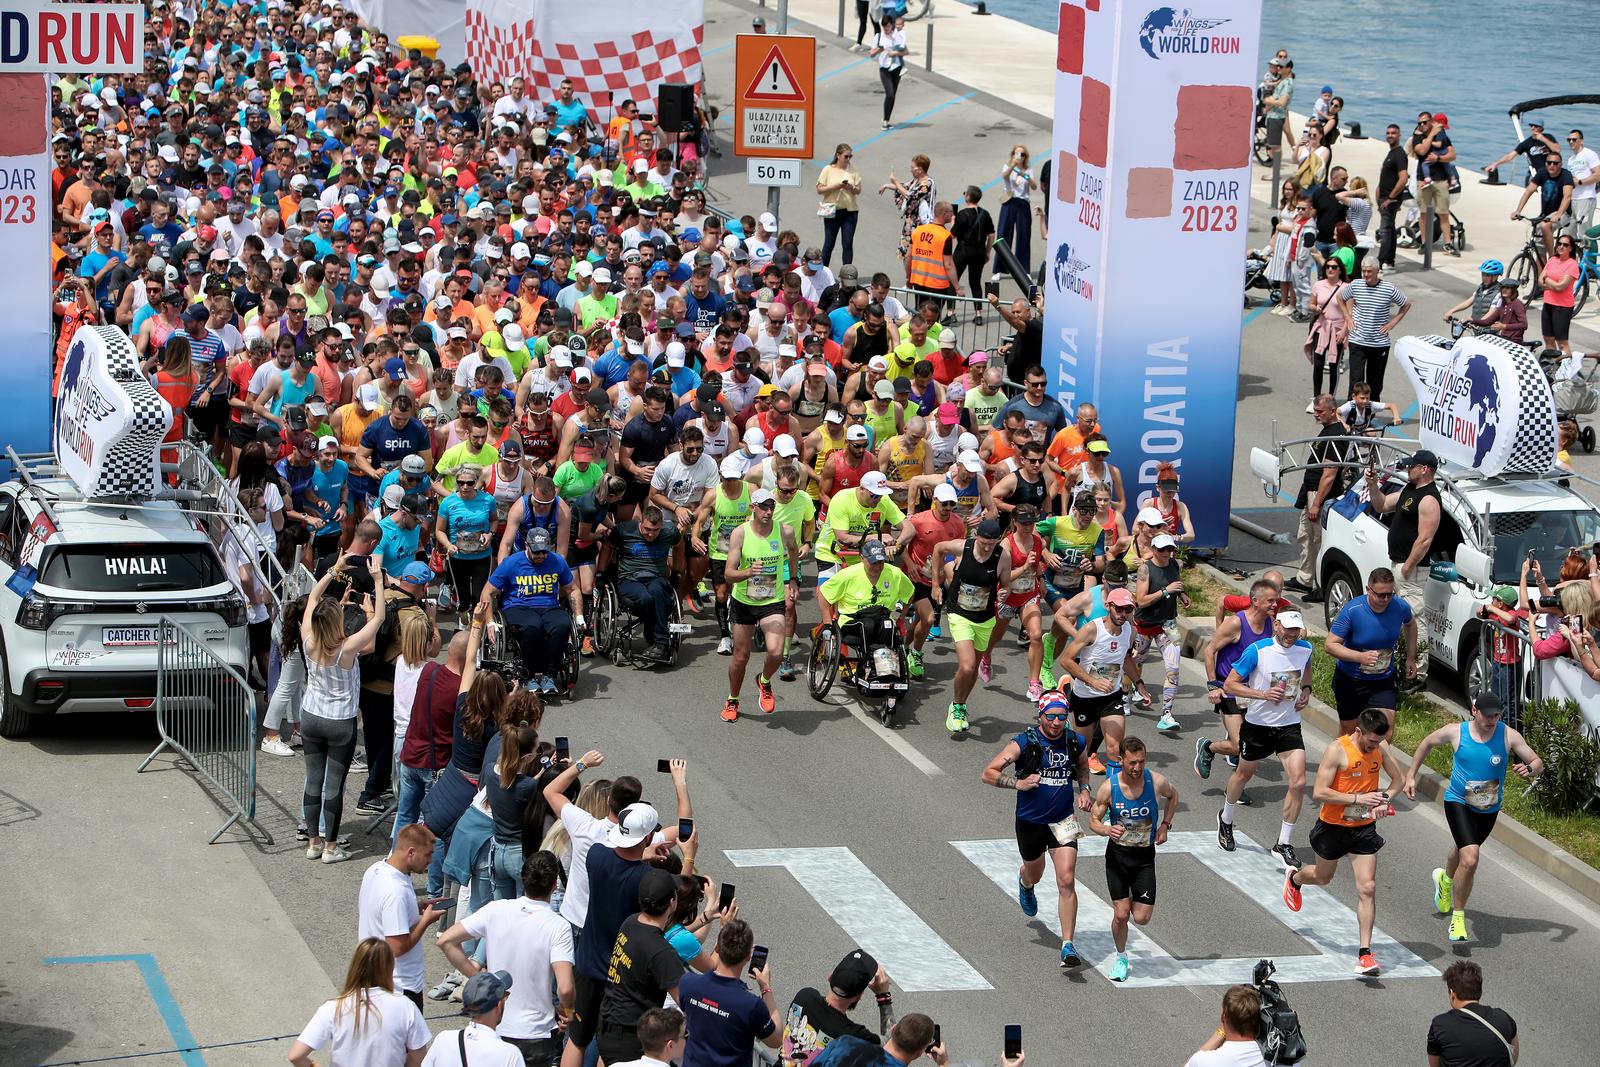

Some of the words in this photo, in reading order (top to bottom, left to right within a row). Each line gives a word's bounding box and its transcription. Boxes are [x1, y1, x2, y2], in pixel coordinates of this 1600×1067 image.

[1173, 19, 1208, 29] WINGS
[1177, 28, 1198, 36] LIFE
[38, 12, 134, 64] RUN
[1159, 36, 1209, 53] WORLD
[1211, 37, 1240, 54] RUN
[749, 112, 800, 122] ULAZ/IZLAZ
[753, 124, 781, 133] VOZILA
[785, 125, 795, 133] SA
[758, 166, 775, 178] 50
[780, 169, 791, 179] m
[1080, 172, 1103, 196] ZADAR
[1183, 181, 1239, 200] ZADAR
[0, 195, 36, 224] 23
[1079, 197, 1101, 231] 2023
[1181, 205, 1238, 232] 2023
[1061, 270, 1081, 294] WORLD
[1081, 280, 1093, 301] RUN
[1434, 367, 1471, 397] WINGS
[77, 375, 100, 415] WINGS
[1433, 389, 1457, 412] LIFE
[1421, 404, 1454, 439] WORLD
[1454, 416, 1476, 448] RUN
[60, 409, 81, 455] WORLD
[80, 430, 94, 468] RUN
[385, 437, 412, 451] spin.
[523, 438, 549, 447] KENYA
[105, 557, 167, 575] HVALA!
[515, 573, 558, 585] WINGS
[525, 584, 553, 595] LIFE
[108, 629, 150, 642] CATCHER
[153, 630, 172, 641] CAR
[58, 650, 91, 659] WINGS
[1120, 806, 1150, 818] GEO
[698, 1001, 709, 1011] THOSE
[709, 1006, 718, 1014] WHO
[719, 1009, 730, 1018] CAN'T
[823, 1036, 829, 1044] S
